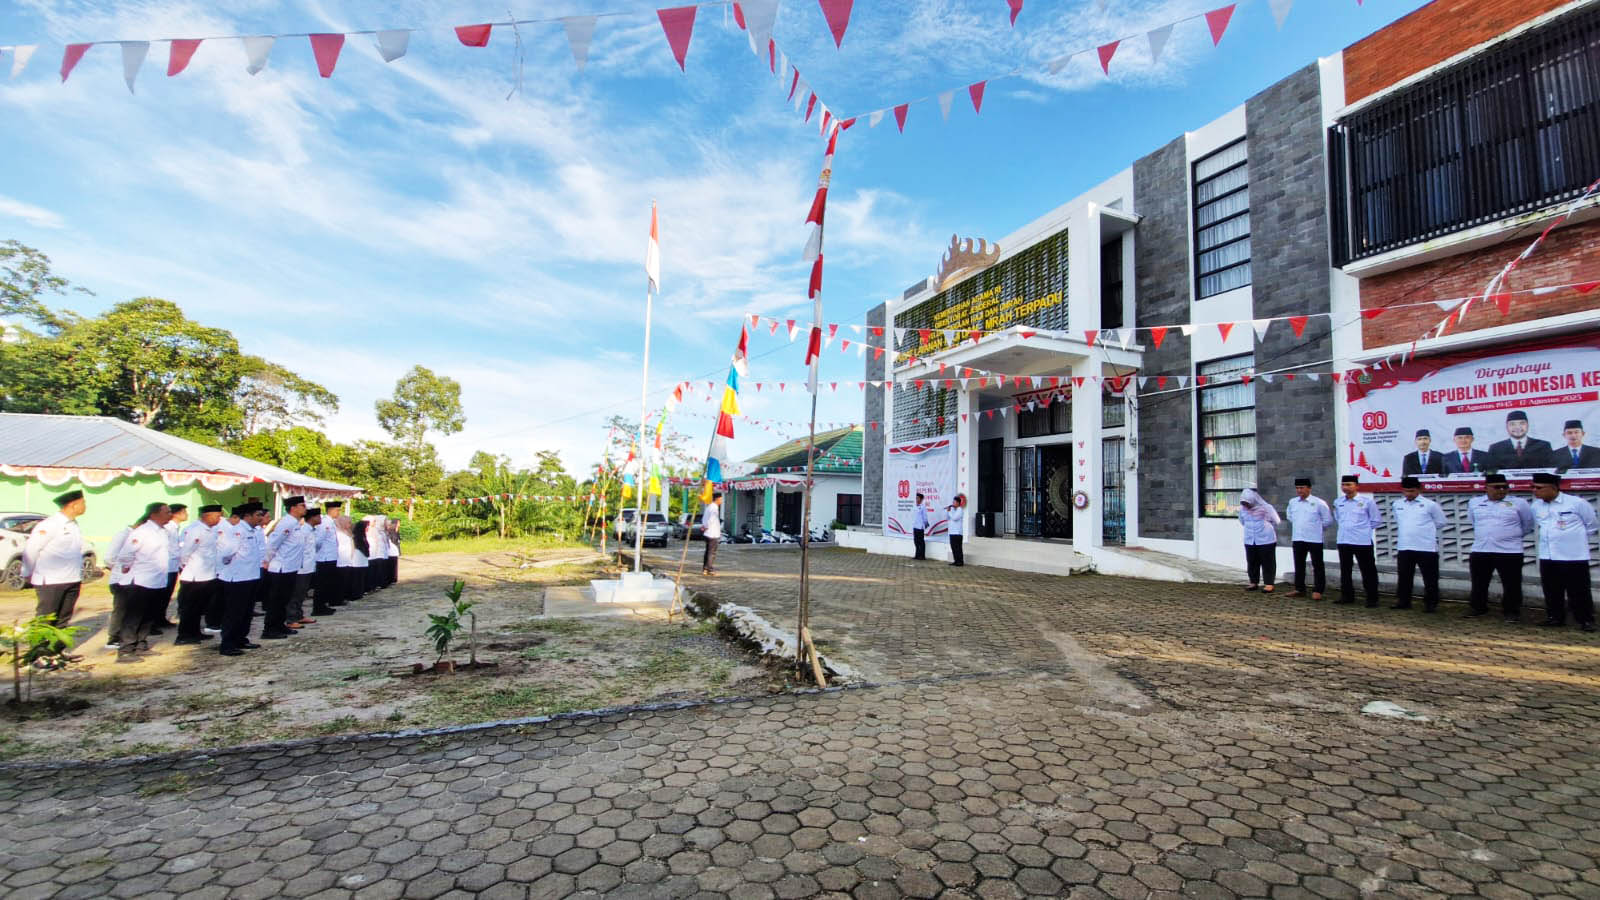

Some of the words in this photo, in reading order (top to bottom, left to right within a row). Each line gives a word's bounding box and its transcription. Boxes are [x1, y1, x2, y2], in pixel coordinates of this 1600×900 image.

[971, 290, 993, 304] AGAMA
[993, 285, 1002, 296] RI
[969, 298, 999, 315] JENDERAL
[985, 306, 998, 318] DAN
[1015, 292, 1064, 318] TERPADU
[1475, 362, 1552, 379] Dirgahayu
[1421, 384, 1488, 405] REPUBLIK
[1493, 373, 1576, 397] INDONESIA
[1562, 393, 1583, 401] 2025
[1362, 411, 1387, 430] 80
